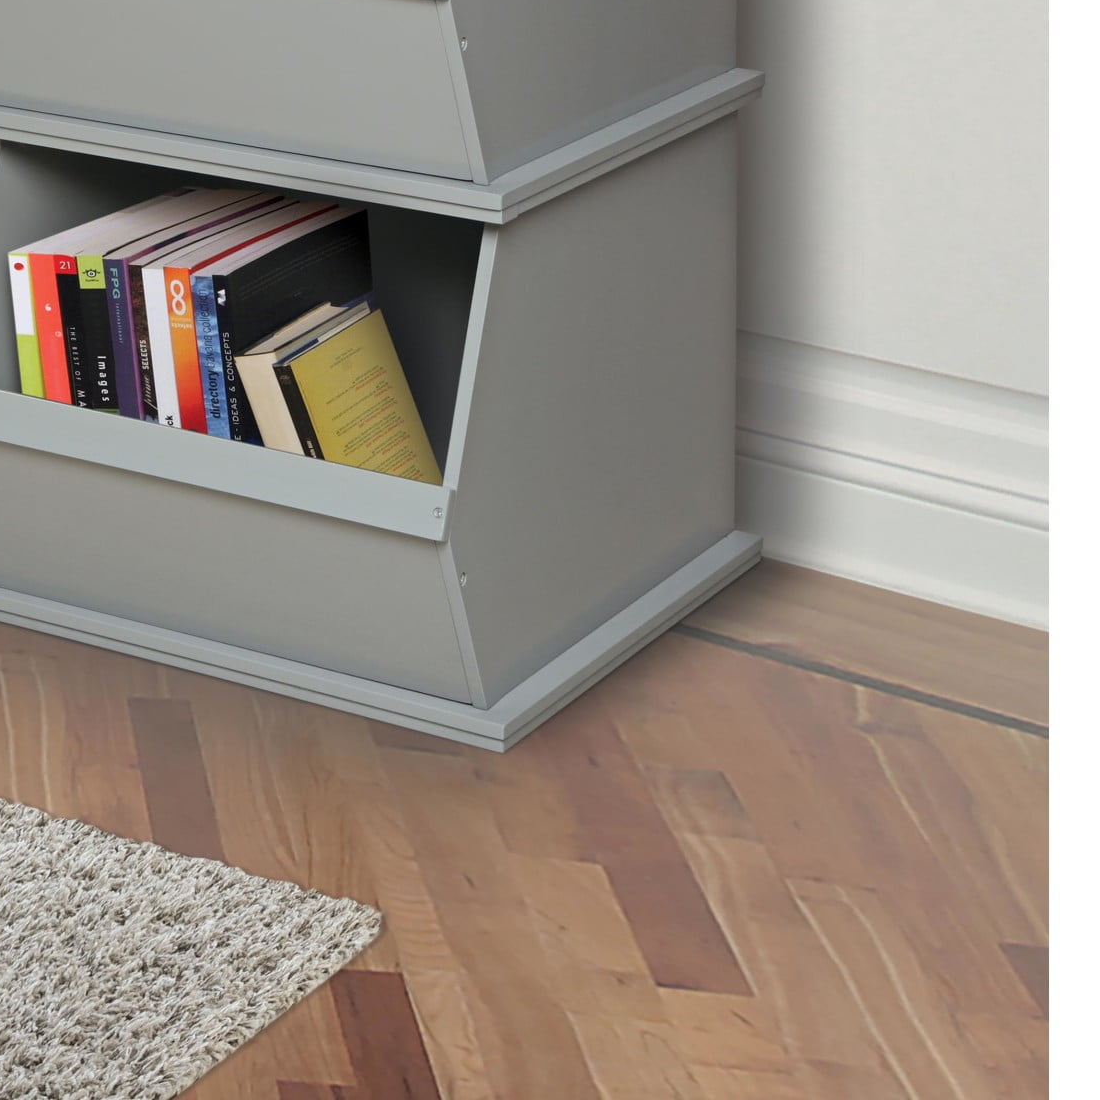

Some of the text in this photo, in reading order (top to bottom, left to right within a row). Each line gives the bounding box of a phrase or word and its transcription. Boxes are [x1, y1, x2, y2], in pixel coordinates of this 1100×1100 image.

[60, 261, 71, 269] 21
[110, 268, 120, 299] FPG
[72, 347, 80, 365] BEST
[140, 340, 149, 370] SELECTS
[223, 332, 235, 381] CONCEPTS
[75, 371, 81, 380] OF
[98, 356, 109, 401] Images
[209, 370, 221, 418] directory
[230, 398, 240, 425] IDEAS
